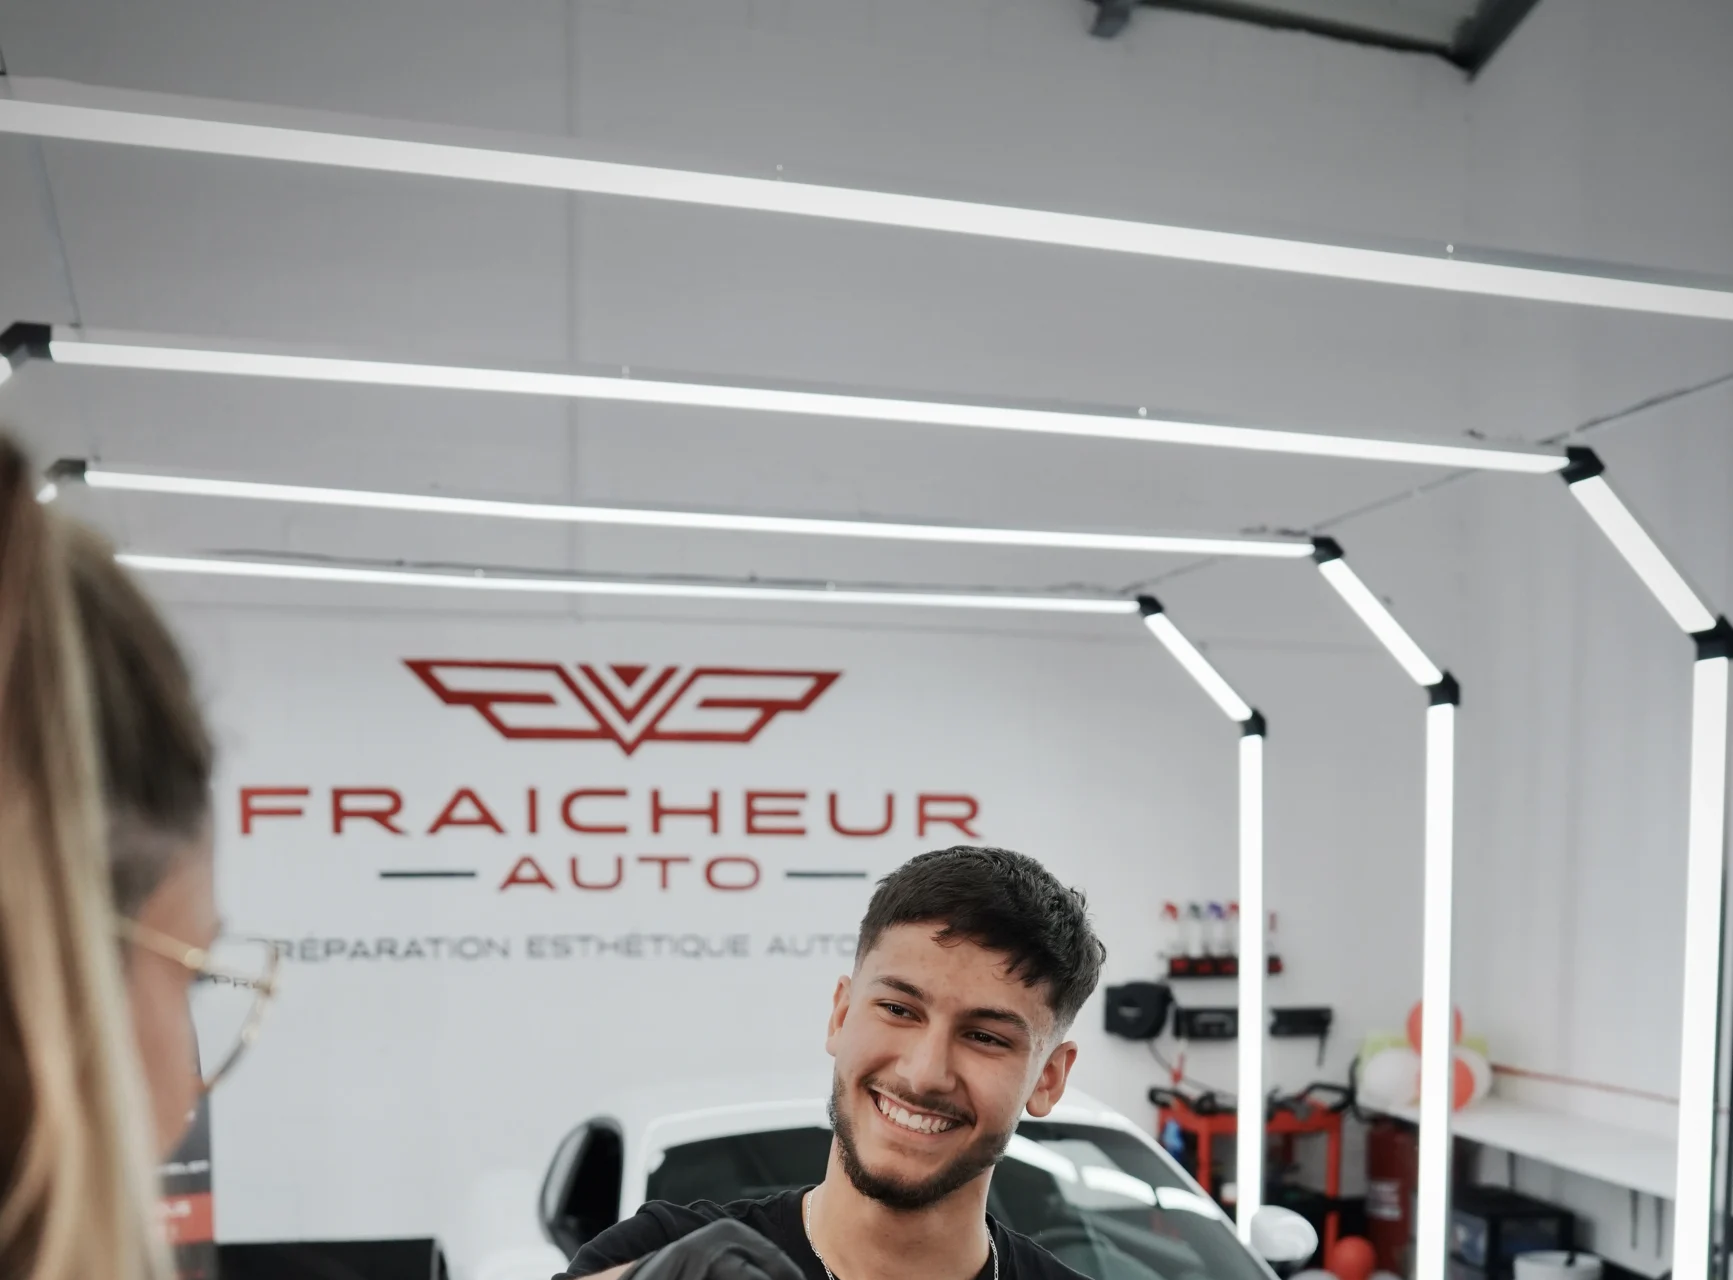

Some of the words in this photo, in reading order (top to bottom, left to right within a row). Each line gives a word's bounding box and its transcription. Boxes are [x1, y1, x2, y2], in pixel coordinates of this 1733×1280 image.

[239, 786, 983, 838] FRAICHEUR
[500, 857, 762, 891] AUTO
[248, 931, 511, 963] RÉPARATION
[526, 928, 751, 961] ESTHÉTIQUE
